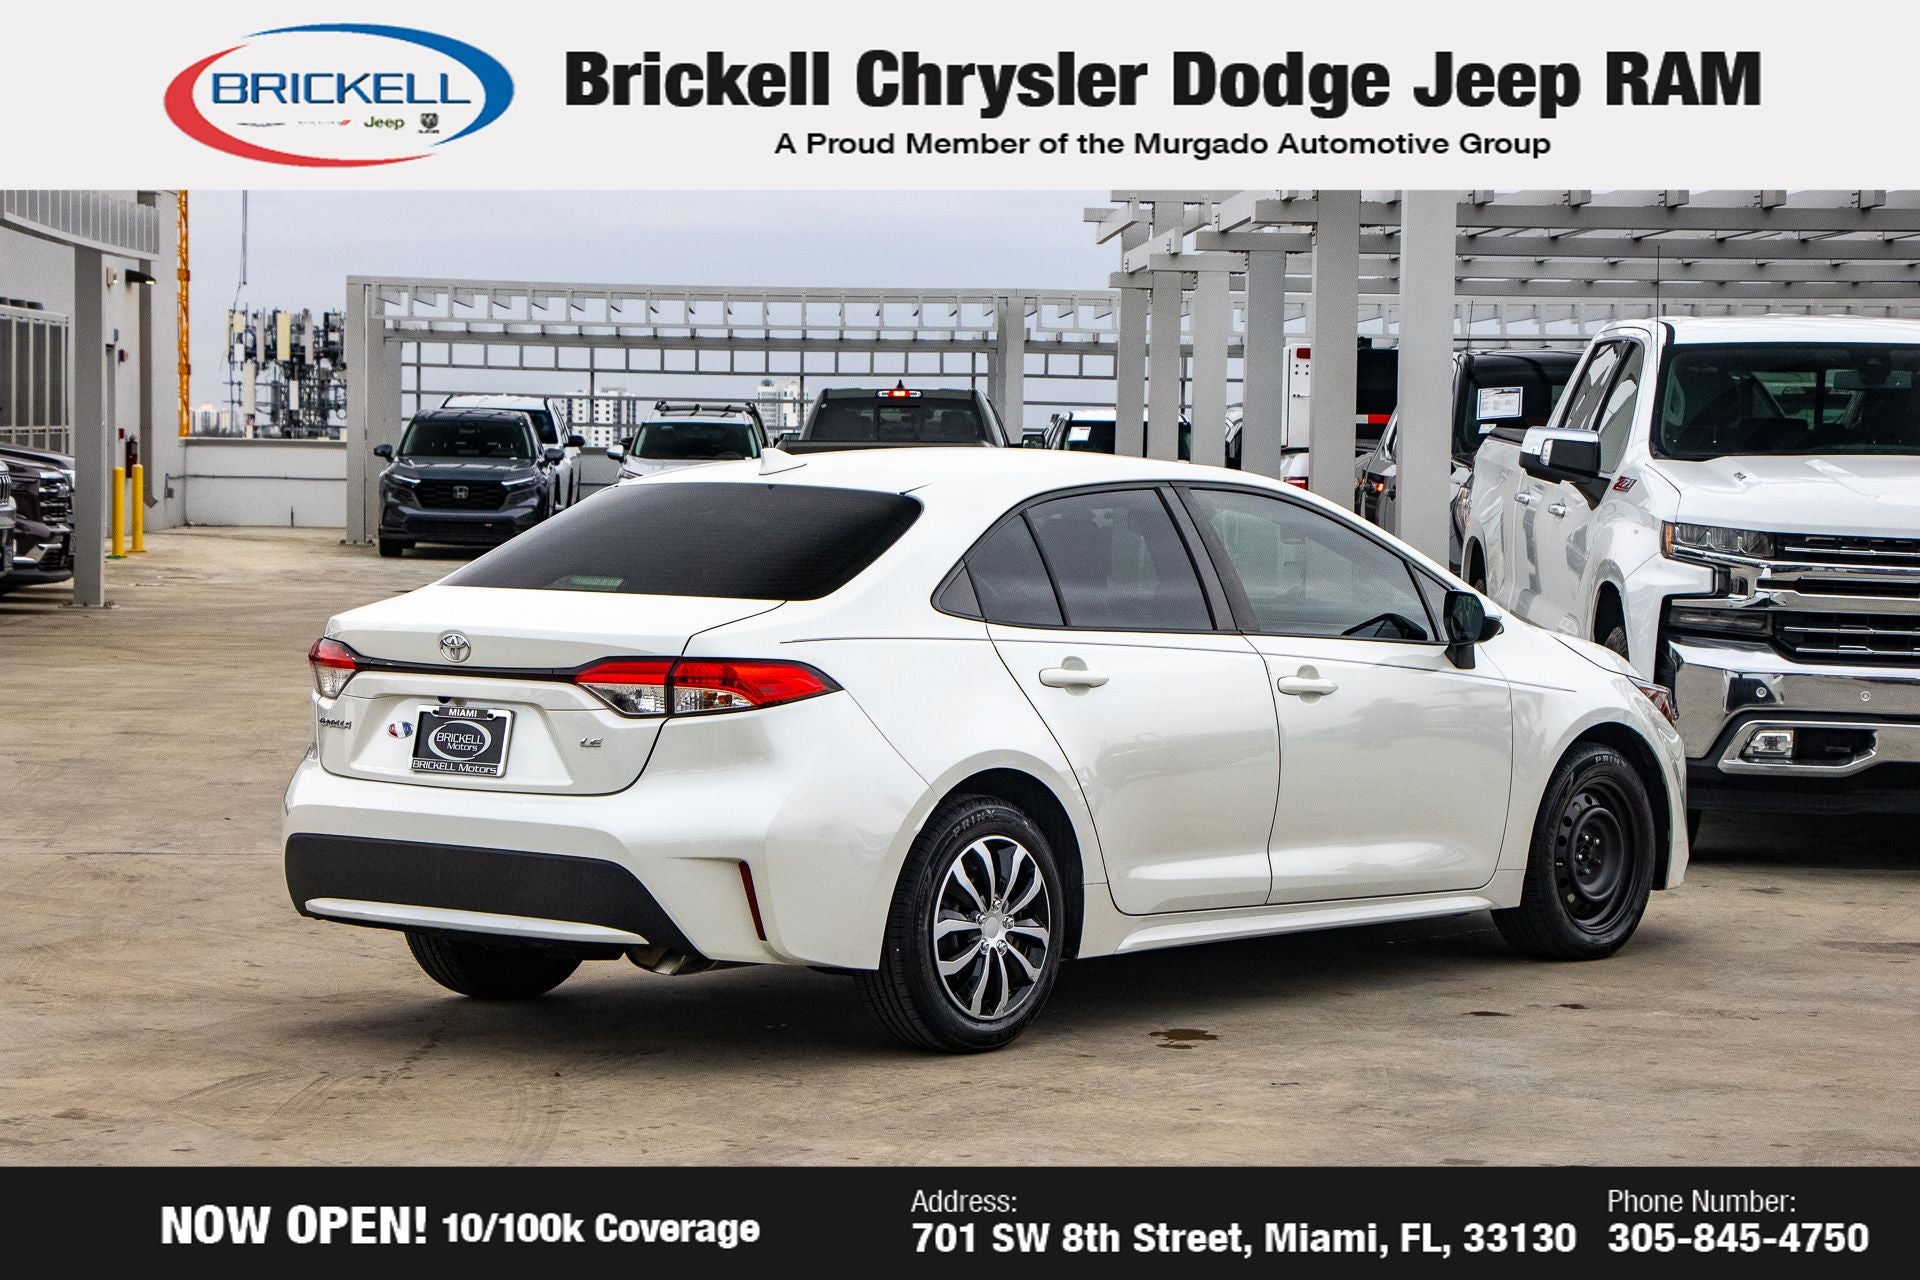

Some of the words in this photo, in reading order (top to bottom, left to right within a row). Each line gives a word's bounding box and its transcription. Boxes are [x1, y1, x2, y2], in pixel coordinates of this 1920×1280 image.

[448, 708, 478, 718] MIAMI
[436, 732, 483, 745] BRICKELL
[446, 742, 478, 752] Motors
[411, 759, 456, 772] BRICKELL
[458, 763, 497, 775] Motors
